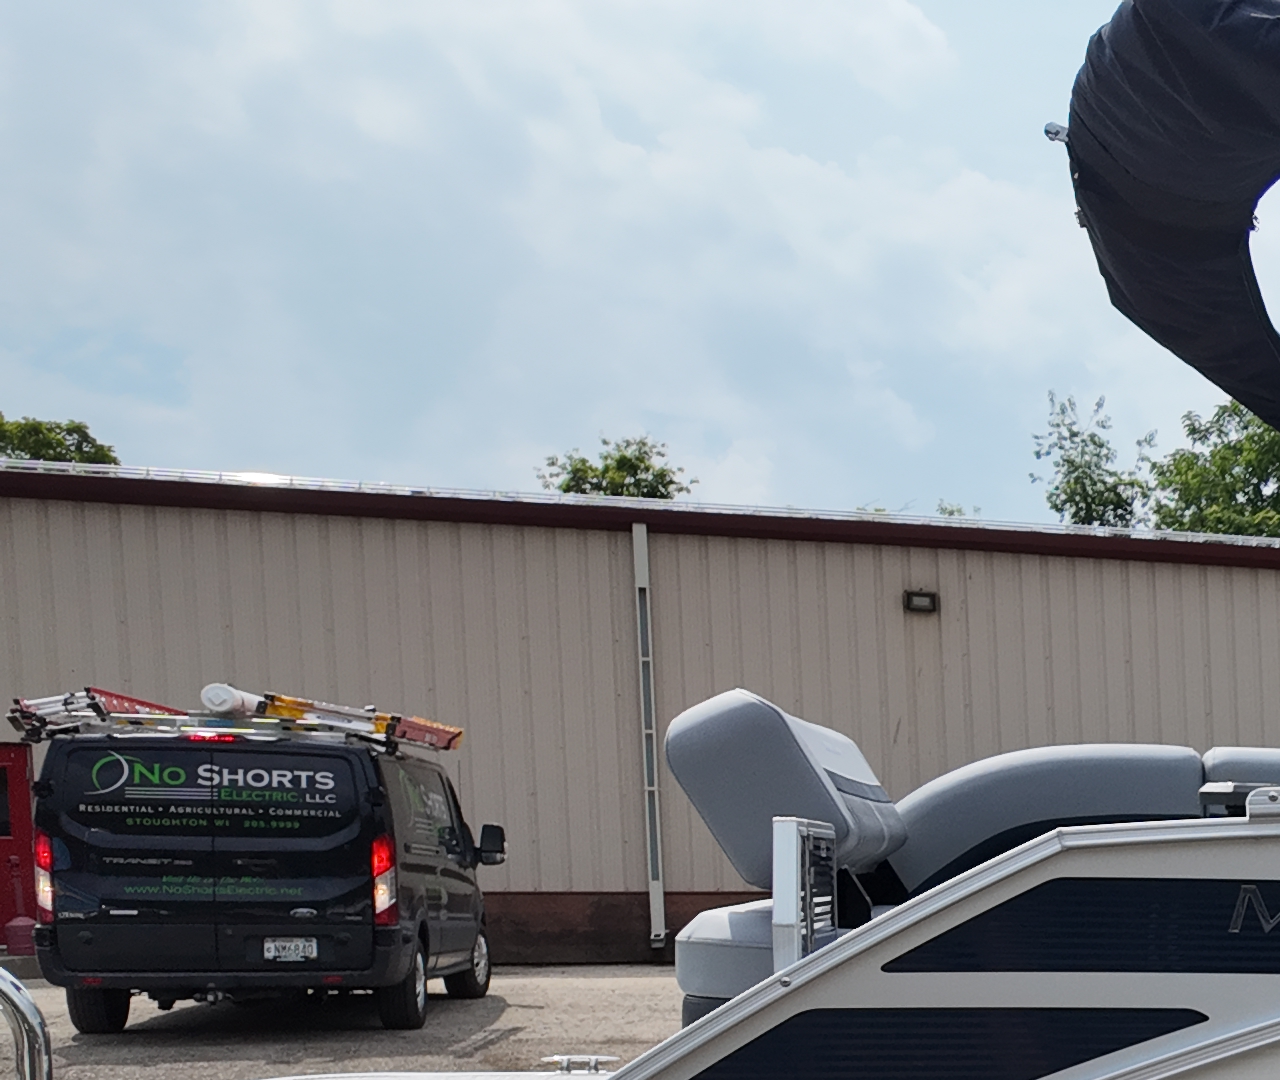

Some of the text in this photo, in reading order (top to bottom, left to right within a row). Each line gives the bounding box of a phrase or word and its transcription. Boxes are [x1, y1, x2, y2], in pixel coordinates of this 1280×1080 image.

[305, 793, 337, 804] LLC
[79, 804, 342, 818] RESIDENTIAL AGRICULTURAL COMMERCIAL
